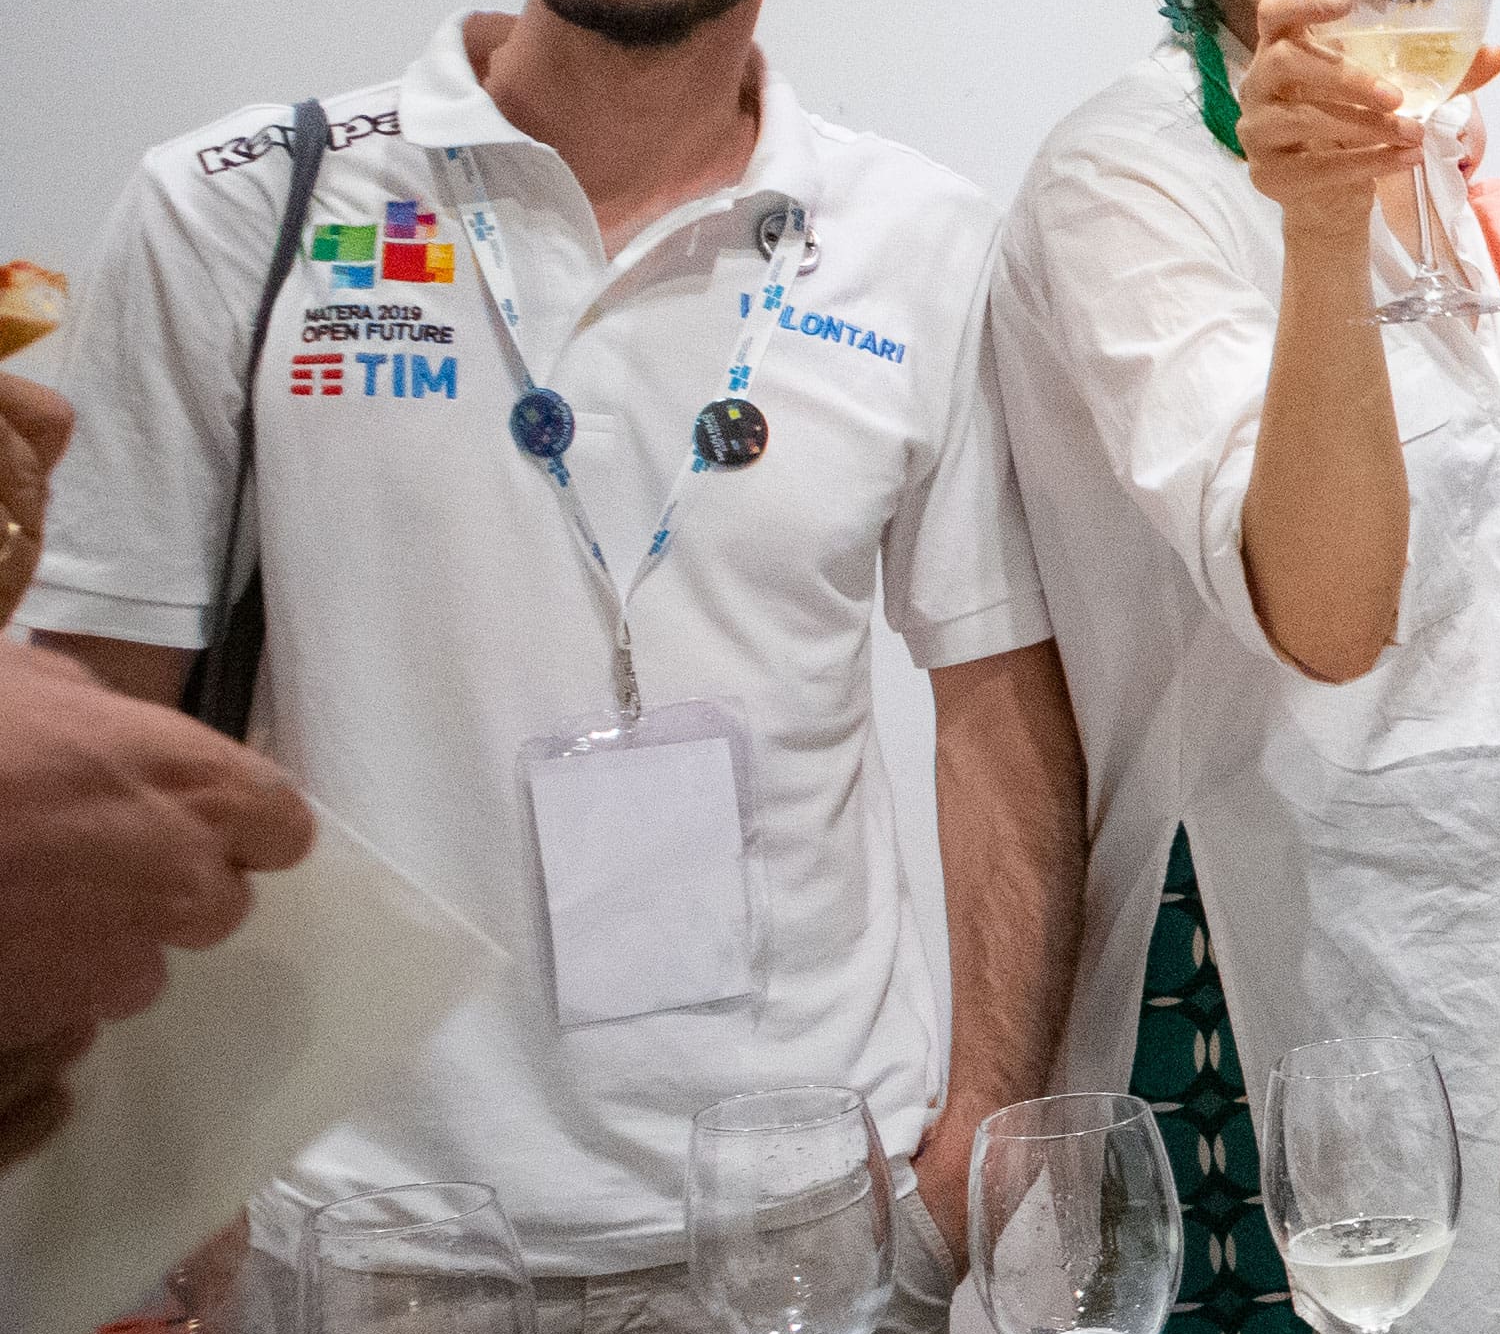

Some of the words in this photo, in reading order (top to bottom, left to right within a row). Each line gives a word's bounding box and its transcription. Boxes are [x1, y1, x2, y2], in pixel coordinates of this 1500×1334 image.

[197, 110, 401, 175] Kapa
[302, 322, 360, 344] OPEN
[365, 323, 455, 345] FUTURE
[304, 304, 371, 324] MATERA
[377, 304, 423, 322] 2019
[740, 292, 907, 364] VLONTARI
[355, 352, 458, 399] TIM
